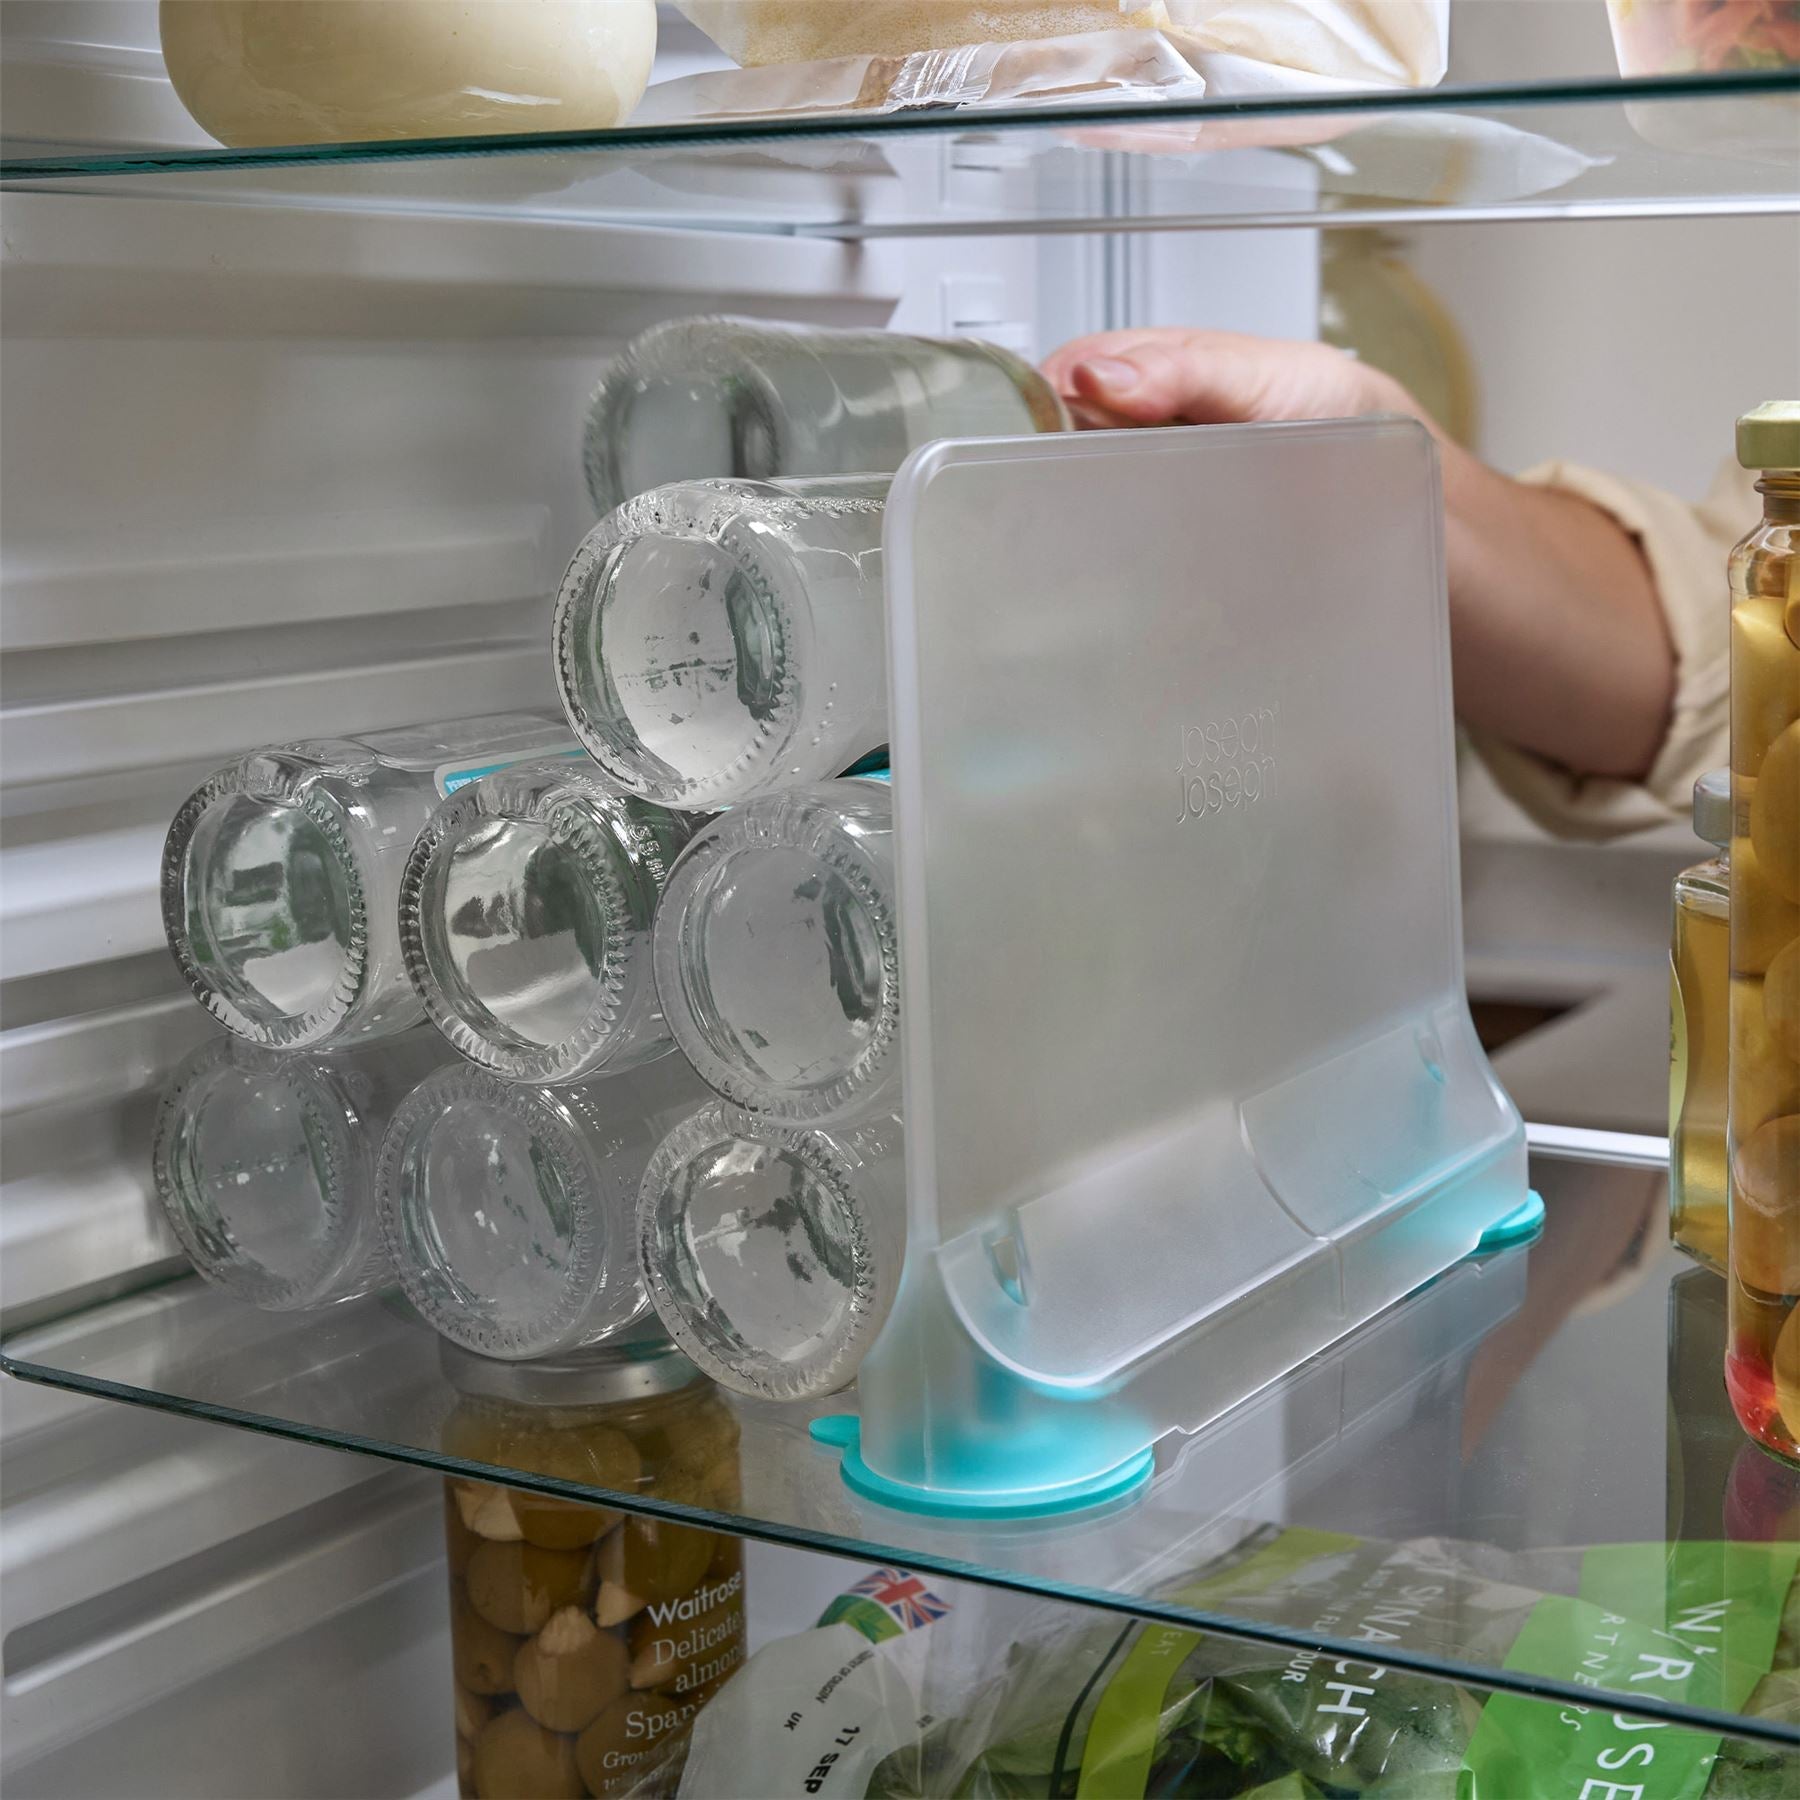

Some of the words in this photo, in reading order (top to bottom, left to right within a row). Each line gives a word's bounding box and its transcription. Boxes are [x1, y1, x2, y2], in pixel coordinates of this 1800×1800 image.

[647, 1571, 742, 1628] Waitrose
[784, 1712, 803, 1731] UK
[835, 1726, 861, 1746] 17
[804, 1753, 840, 1794] SEP
